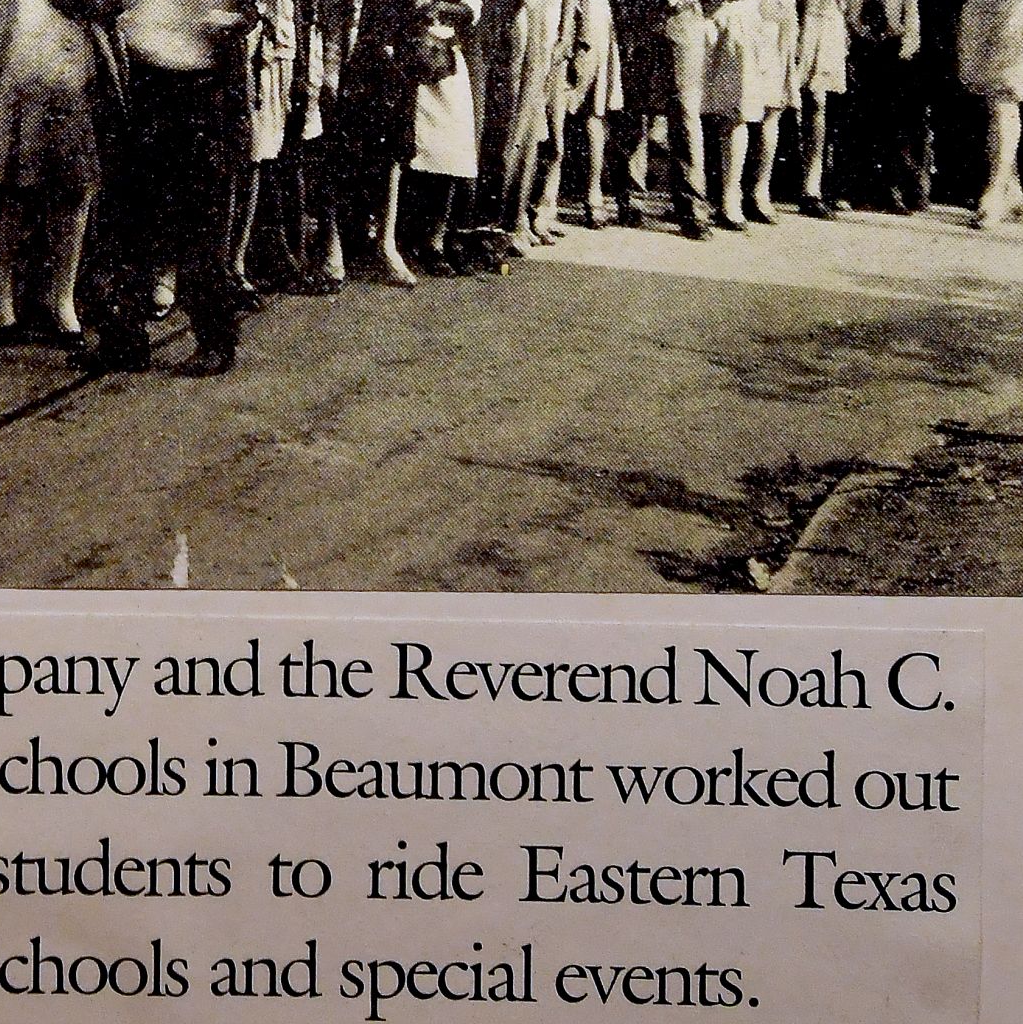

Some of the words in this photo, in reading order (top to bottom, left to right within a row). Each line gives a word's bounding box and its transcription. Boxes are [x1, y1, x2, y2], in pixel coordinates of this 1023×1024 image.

[153, 637, 266, 698] and
[278, 638, 374, 699] the
[388, 642, 683, 705] Reverend
[693, 648, 873, 710] Noah
[887, 652, 955, 712] C.
[202, 737, 264, 798] in
[275, 741, 595, 803] Beaumont
[605, 747, 842, 809] worked
[854, 767, 961, 812] out
[267, 852, 332, 899] to
[366, 839, 485, 902] ride
[518, 844, 751, 908] Eastern
[782, 848, 957, 914] Texas
[210, 938, 323, 999] and
[339, 941, 538, 1022] special
[554, 961, 760, 1008] events.
